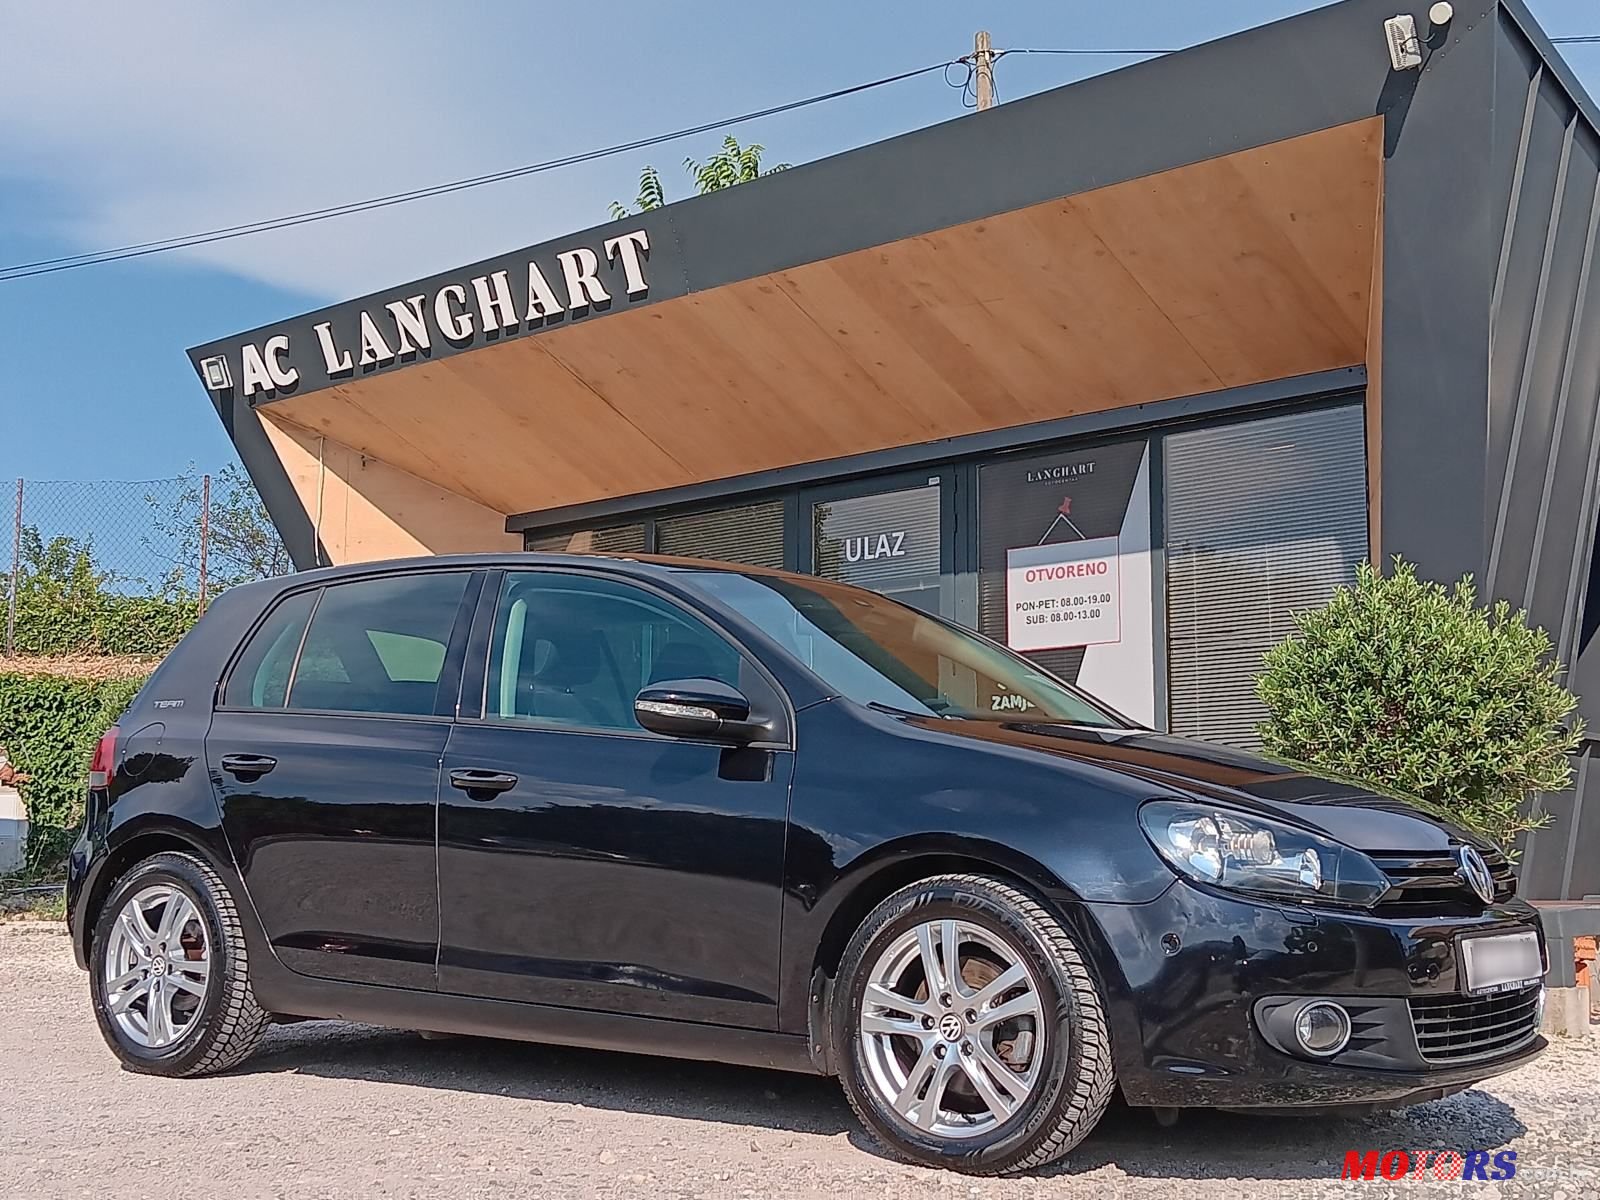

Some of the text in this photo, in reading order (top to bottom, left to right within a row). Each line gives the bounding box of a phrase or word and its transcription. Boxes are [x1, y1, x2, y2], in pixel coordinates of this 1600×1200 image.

[242, 230, 649, 396] AC LANGHART
[1027, 462, 1096, 482] LANGHART
[845, 531, 905, 562] ULAZ
[1025, 561, 1108, 583] OTVORENO
[1015, 593, 1111, 612] PON-PET: 08.00-19.00
[1025, 608, 1101, 625] SUB: 08.00-13.00
[153, 699, 185, 709] TEAM
